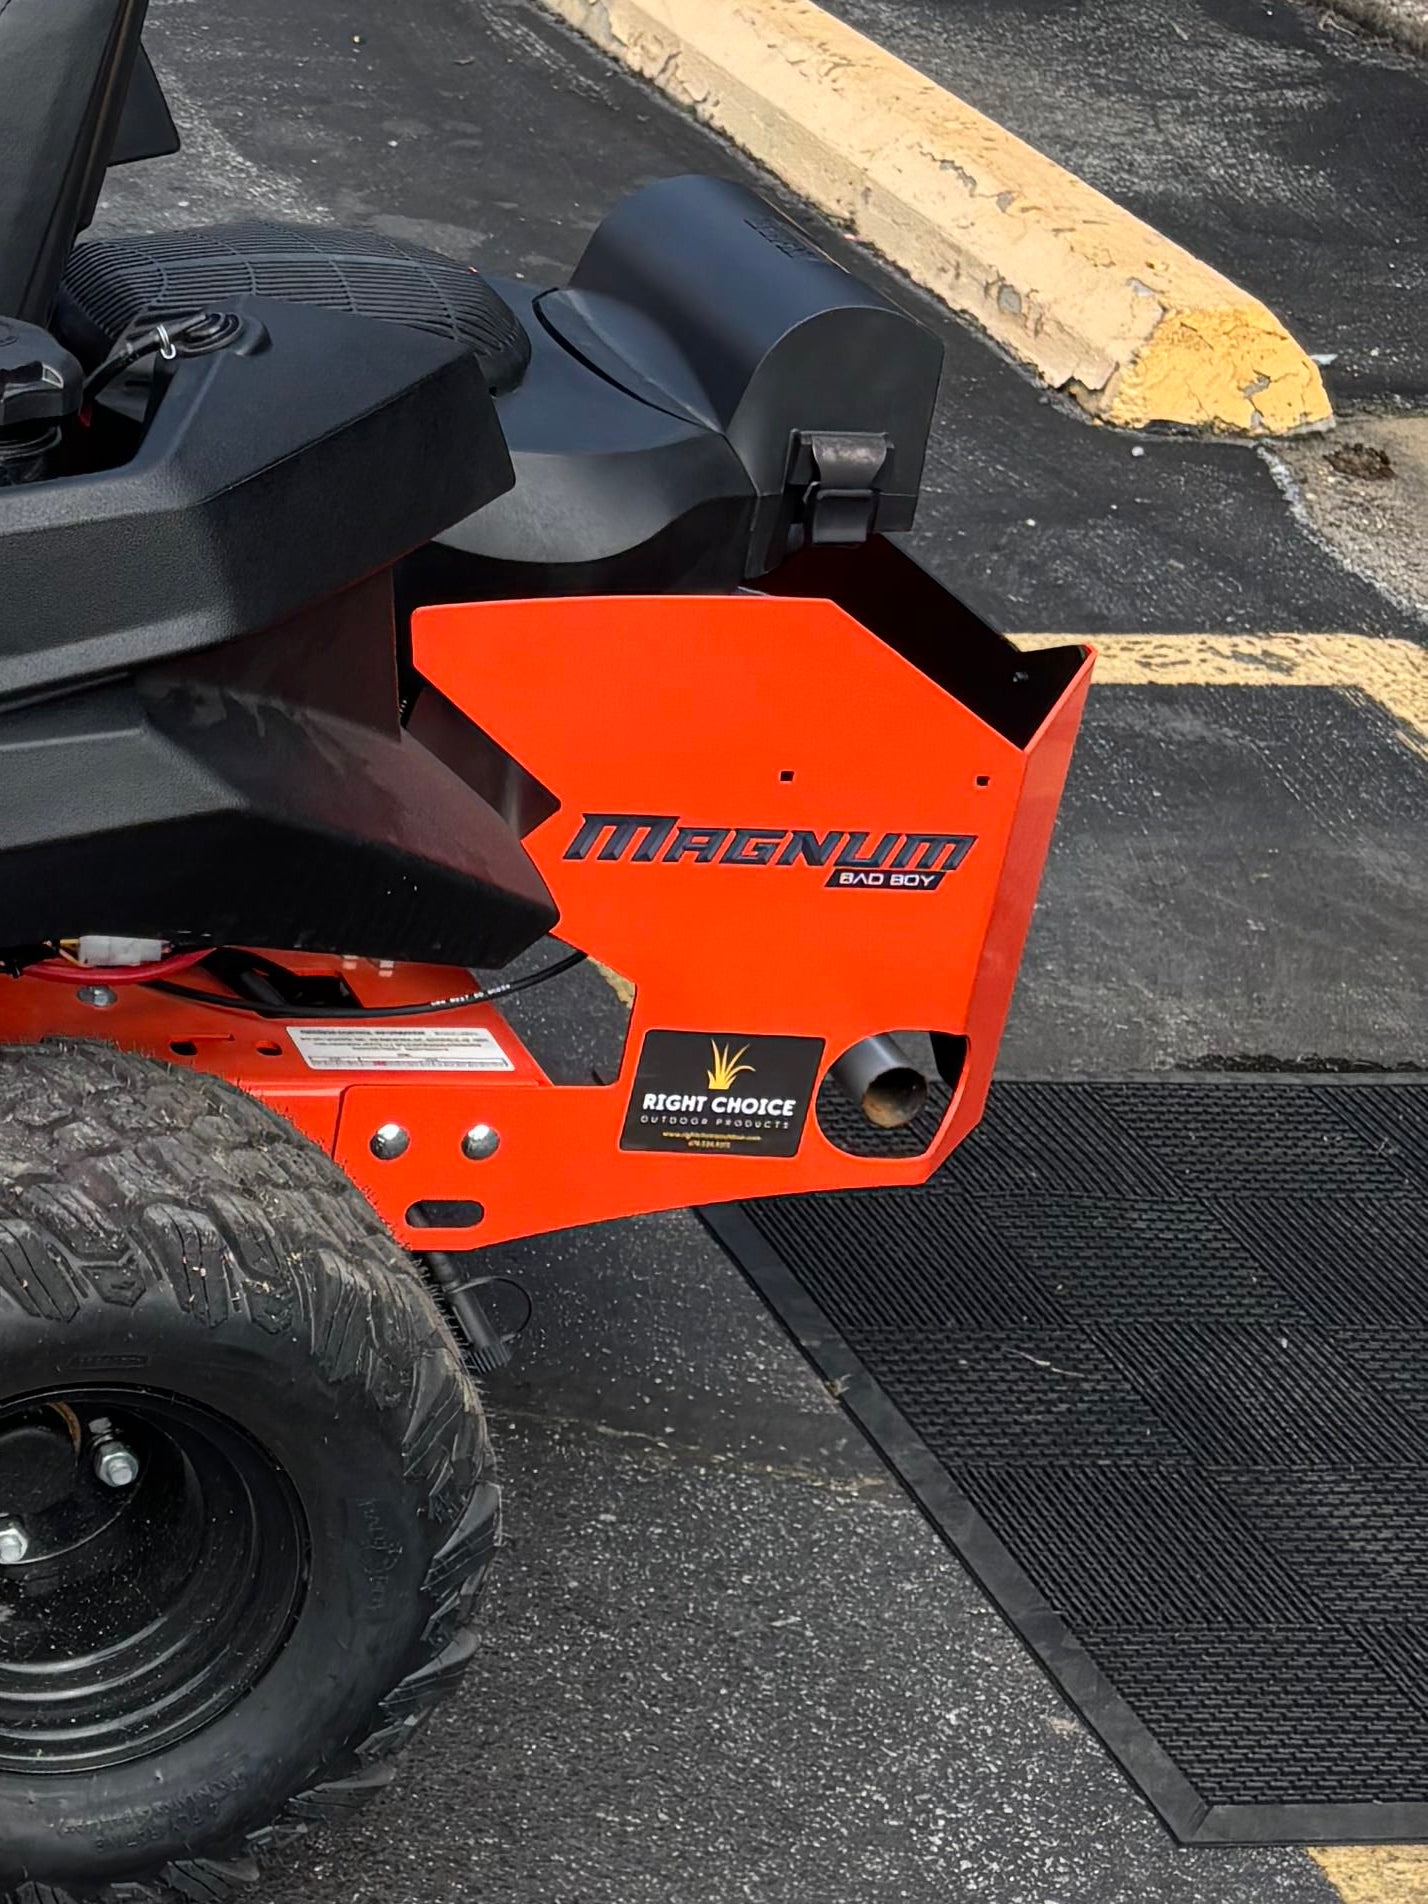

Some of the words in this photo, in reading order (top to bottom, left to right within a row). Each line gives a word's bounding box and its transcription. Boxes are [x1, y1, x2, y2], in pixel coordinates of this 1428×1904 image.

[562, 812, 979, 871] MAGNUM
[839, 871, 884, 887] BAD
[889, 872, 937, 888] BOY
[642, 1093, 708, 1113] RIGHT
[710, 1096, 796, 1117] CHOICE
[639, 1114, 709, 1126] OUTDOOR
[715, 1117, 790, 1130] PRODUCTS
